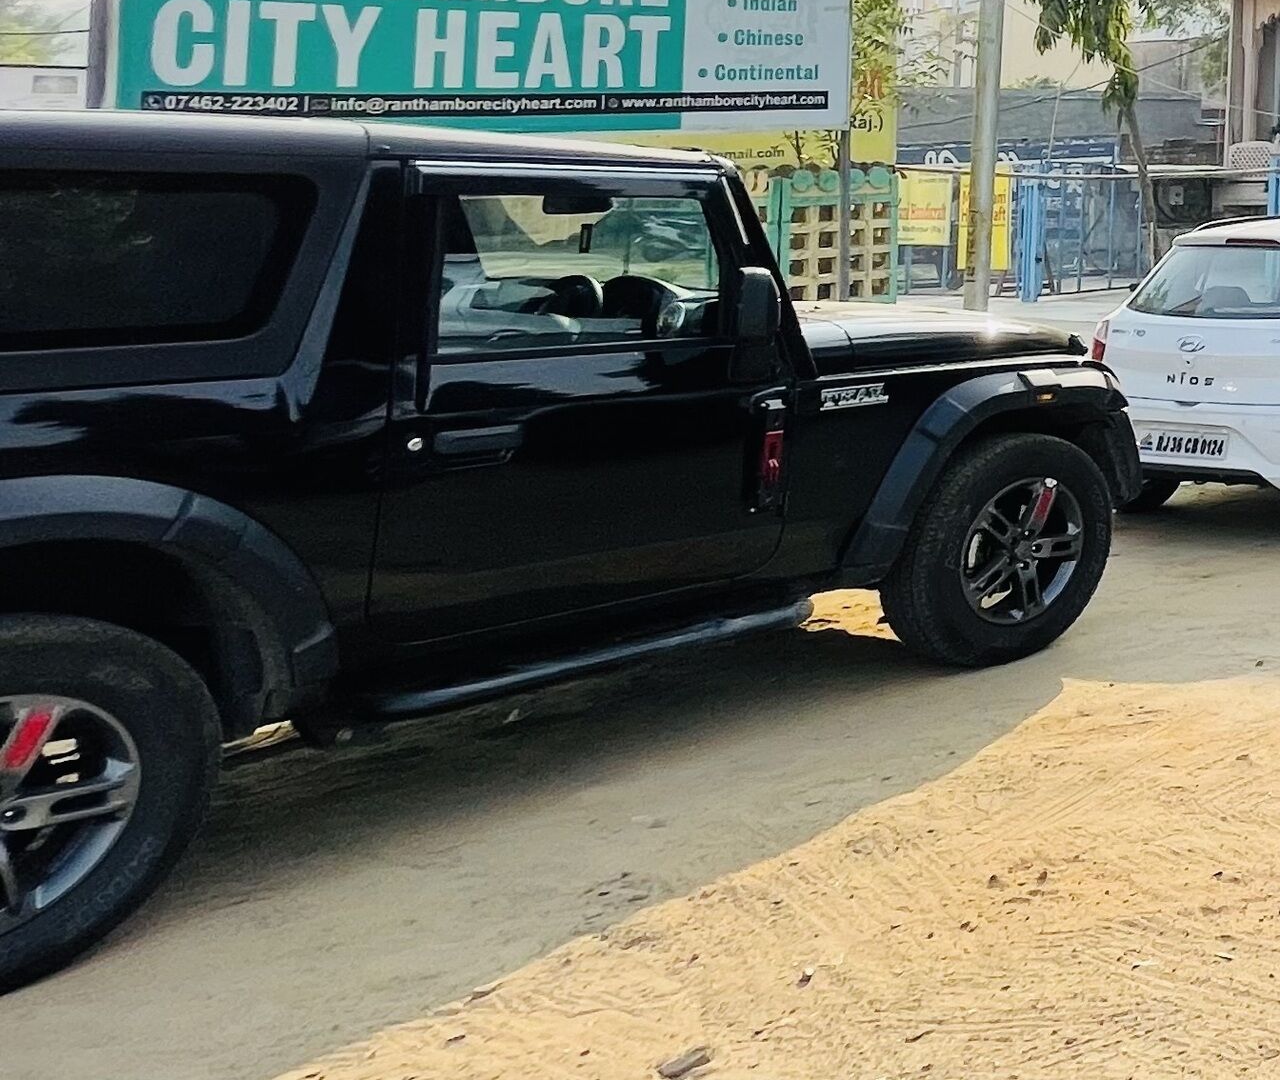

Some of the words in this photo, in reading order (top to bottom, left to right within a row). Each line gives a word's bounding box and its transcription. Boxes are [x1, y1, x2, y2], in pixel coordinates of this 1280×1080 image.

[734, 29, 804, 46] Chinese
[413, 8, 672, 89] HEART
[714, 64, 819, 81] Continental
[164, 95, 299, 112] 07462-223402
[331, 97, 597, 115] info@ranthamborecityheart.com
[621, 94, 826, 110] www.ranthamborecityheart.com
